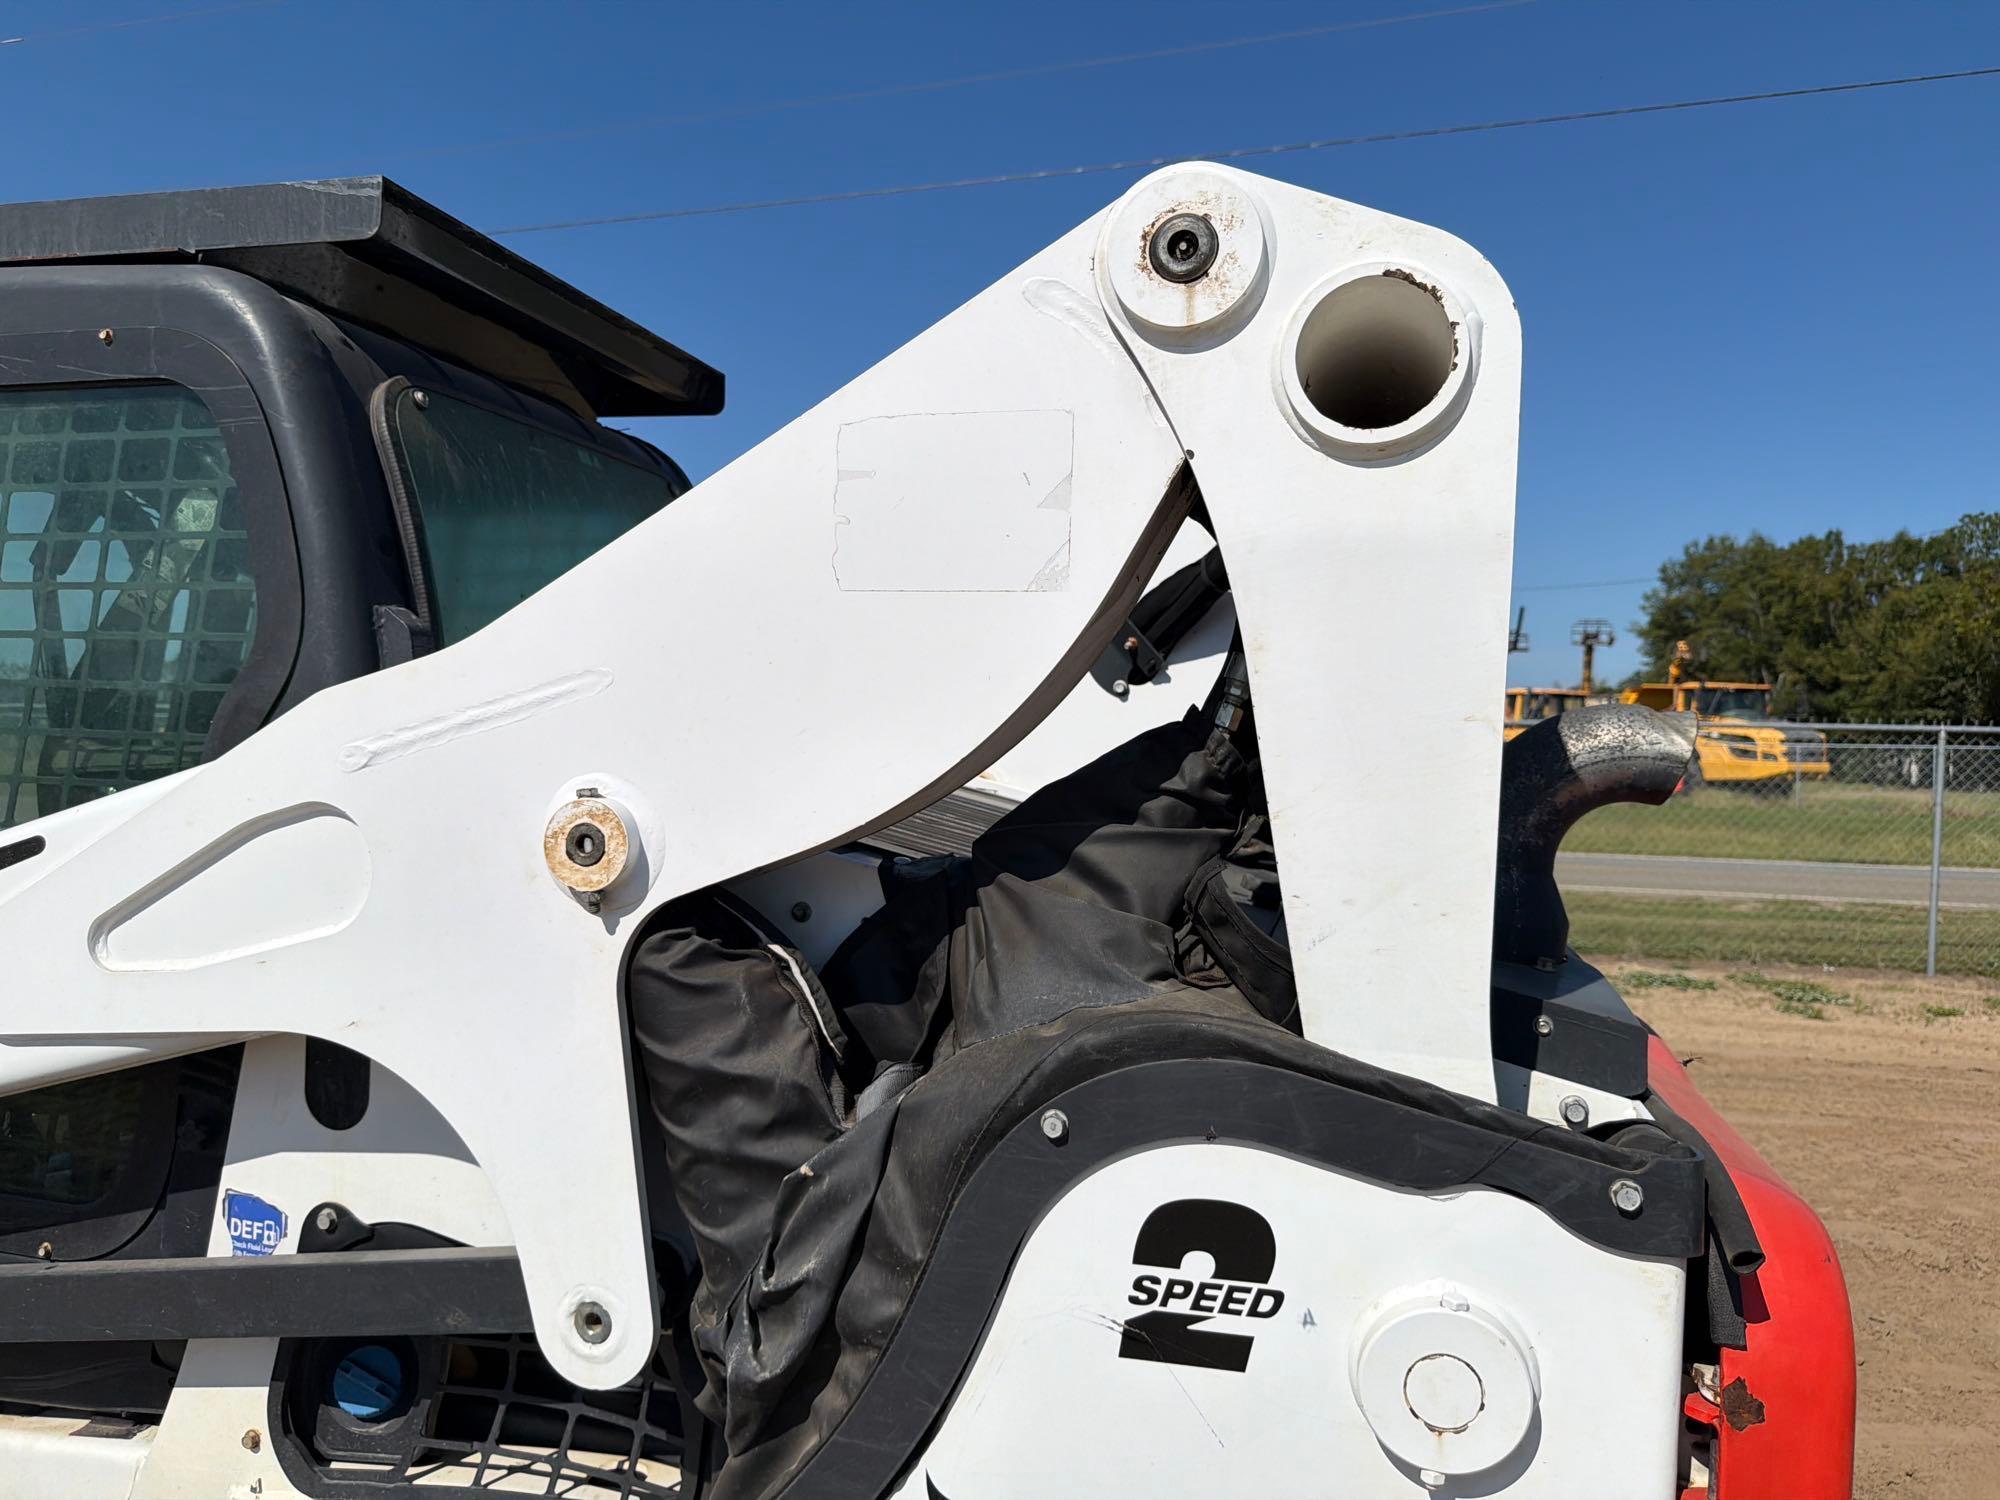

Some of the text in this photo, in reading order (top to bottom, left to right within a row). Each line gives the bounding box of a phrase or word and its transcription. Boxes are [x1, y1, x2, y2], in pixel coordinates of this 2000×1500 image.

[231, 1217, 263, 1239] DEF
[1118, 1198, 1277, 1374] 2
[1127, 1273, 1285, 1319] SPEED
